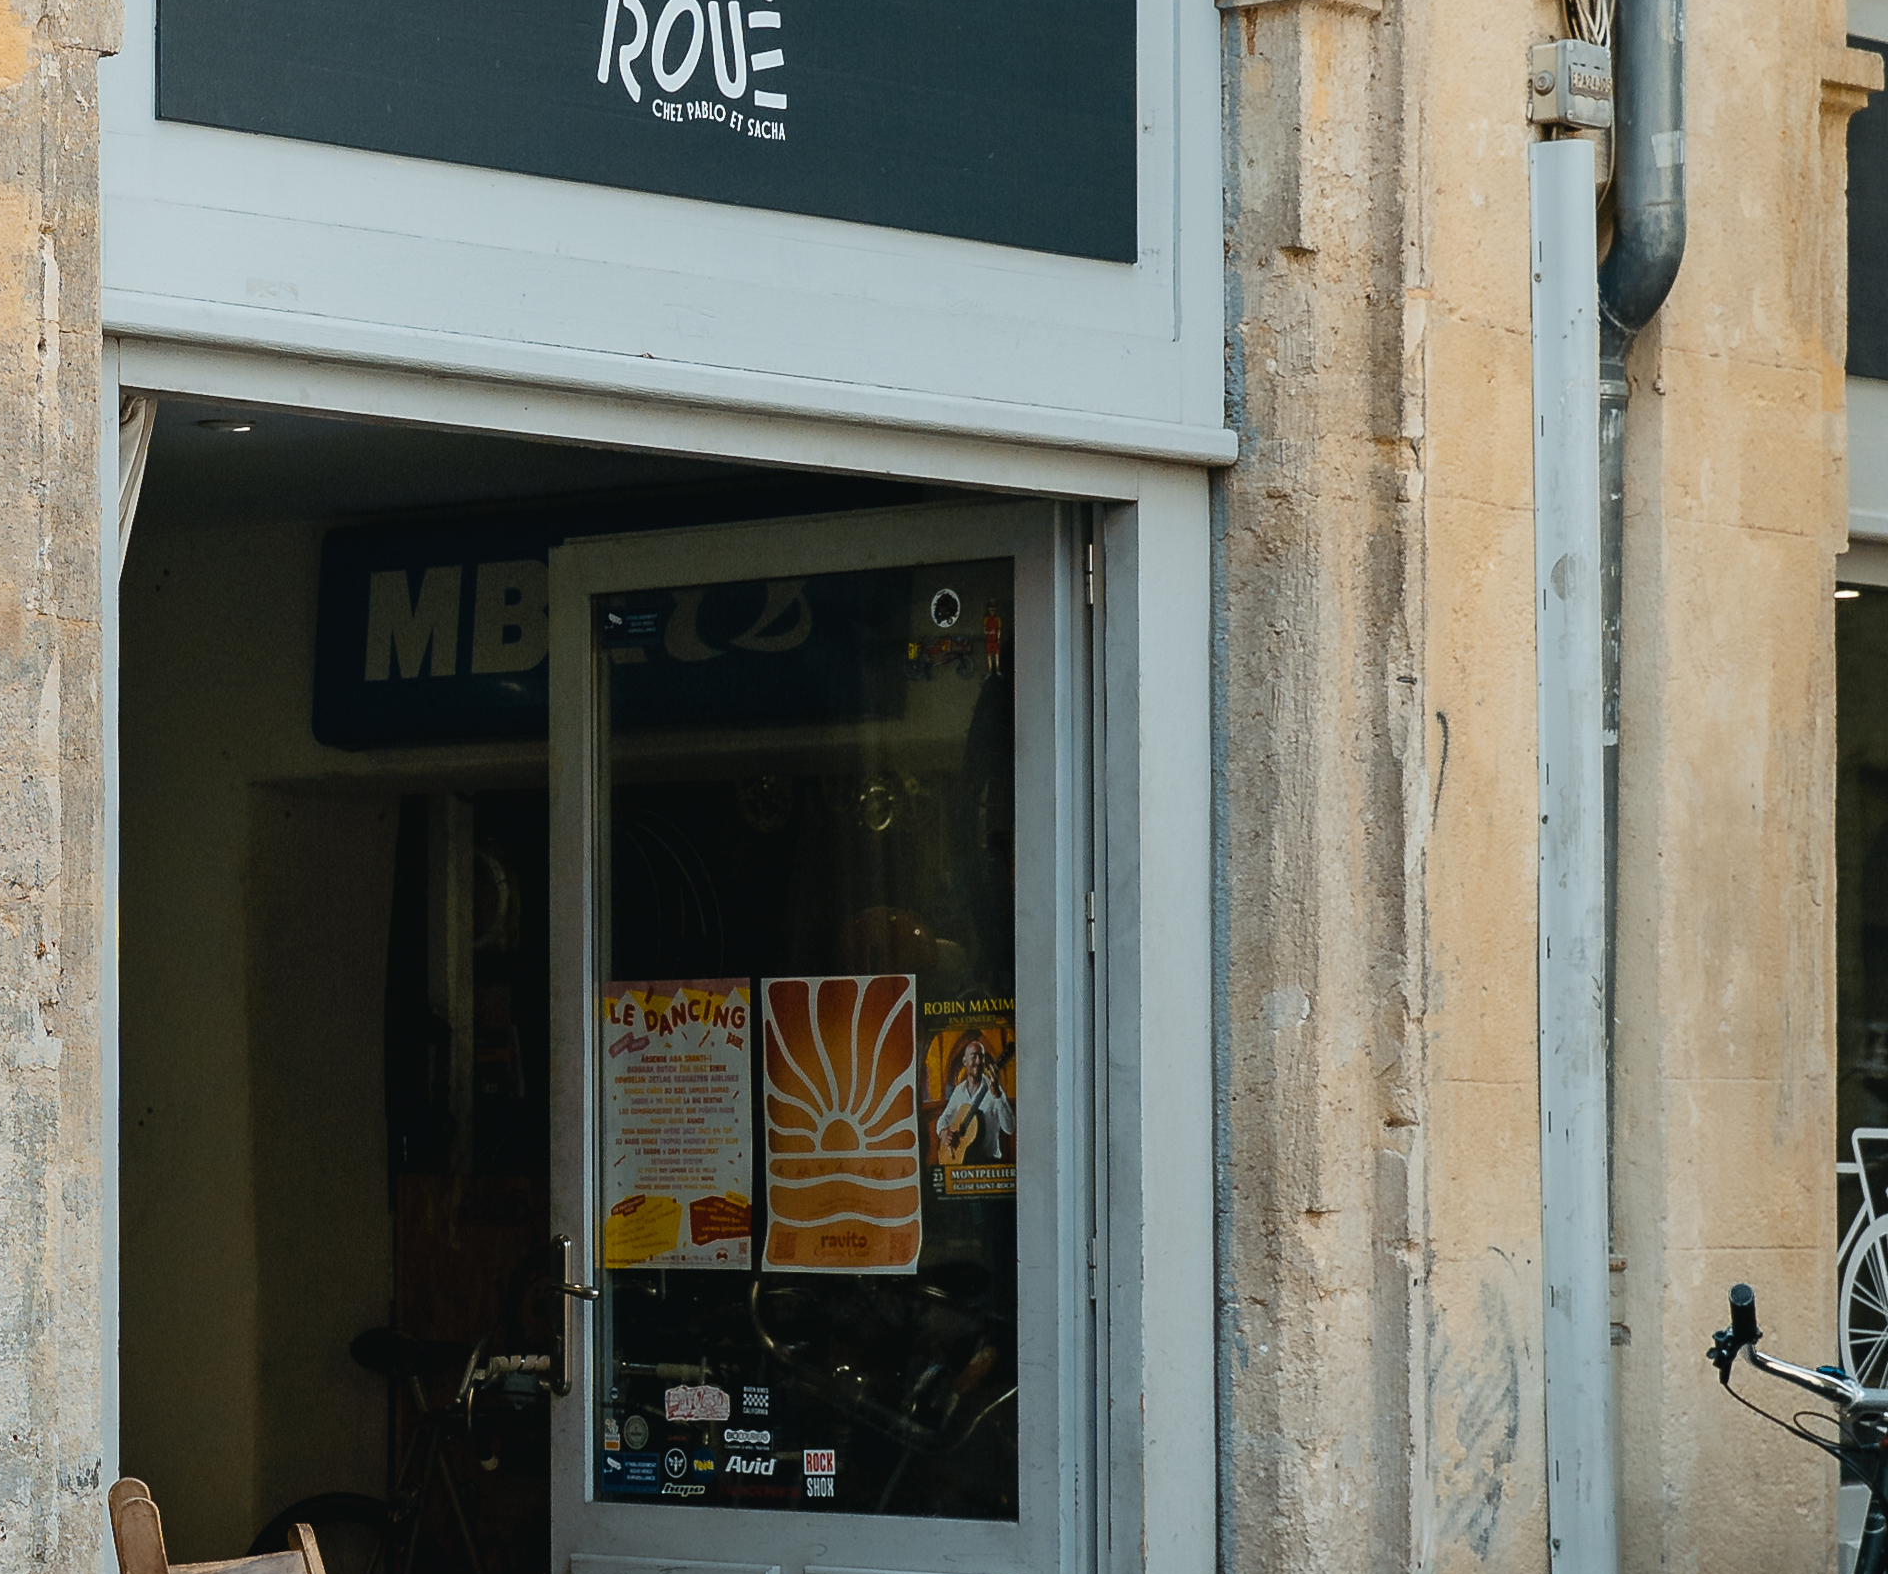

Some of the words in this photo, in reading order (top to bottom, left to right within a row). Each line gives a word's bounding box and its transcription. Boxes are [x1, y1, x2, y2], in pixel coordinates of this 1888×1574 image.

[652, 98, 684, 123] CHEZ
[686, 100, 727, 123] PABLO
[729, 110, 744, 132] ET
[747, 117, 787, 142] SACHA
[609, 1002, 636, 1027] LE
[643, 990, 746, 1038] DANCING
[924, 1000, 965, 1015] ROBIN
[933, 1172, 944, 1182] 23
[951, 1168, 1016, 1180] MONTPELLIER
[821, 1230, 868, 1248] ravito
[724, 1455, 777, 1476] Avid
[806, 1452, 834, 1473] ROCK
[662, 1482, 705, 1497] hope
[806, 1477, 834, 1498] SHOX
